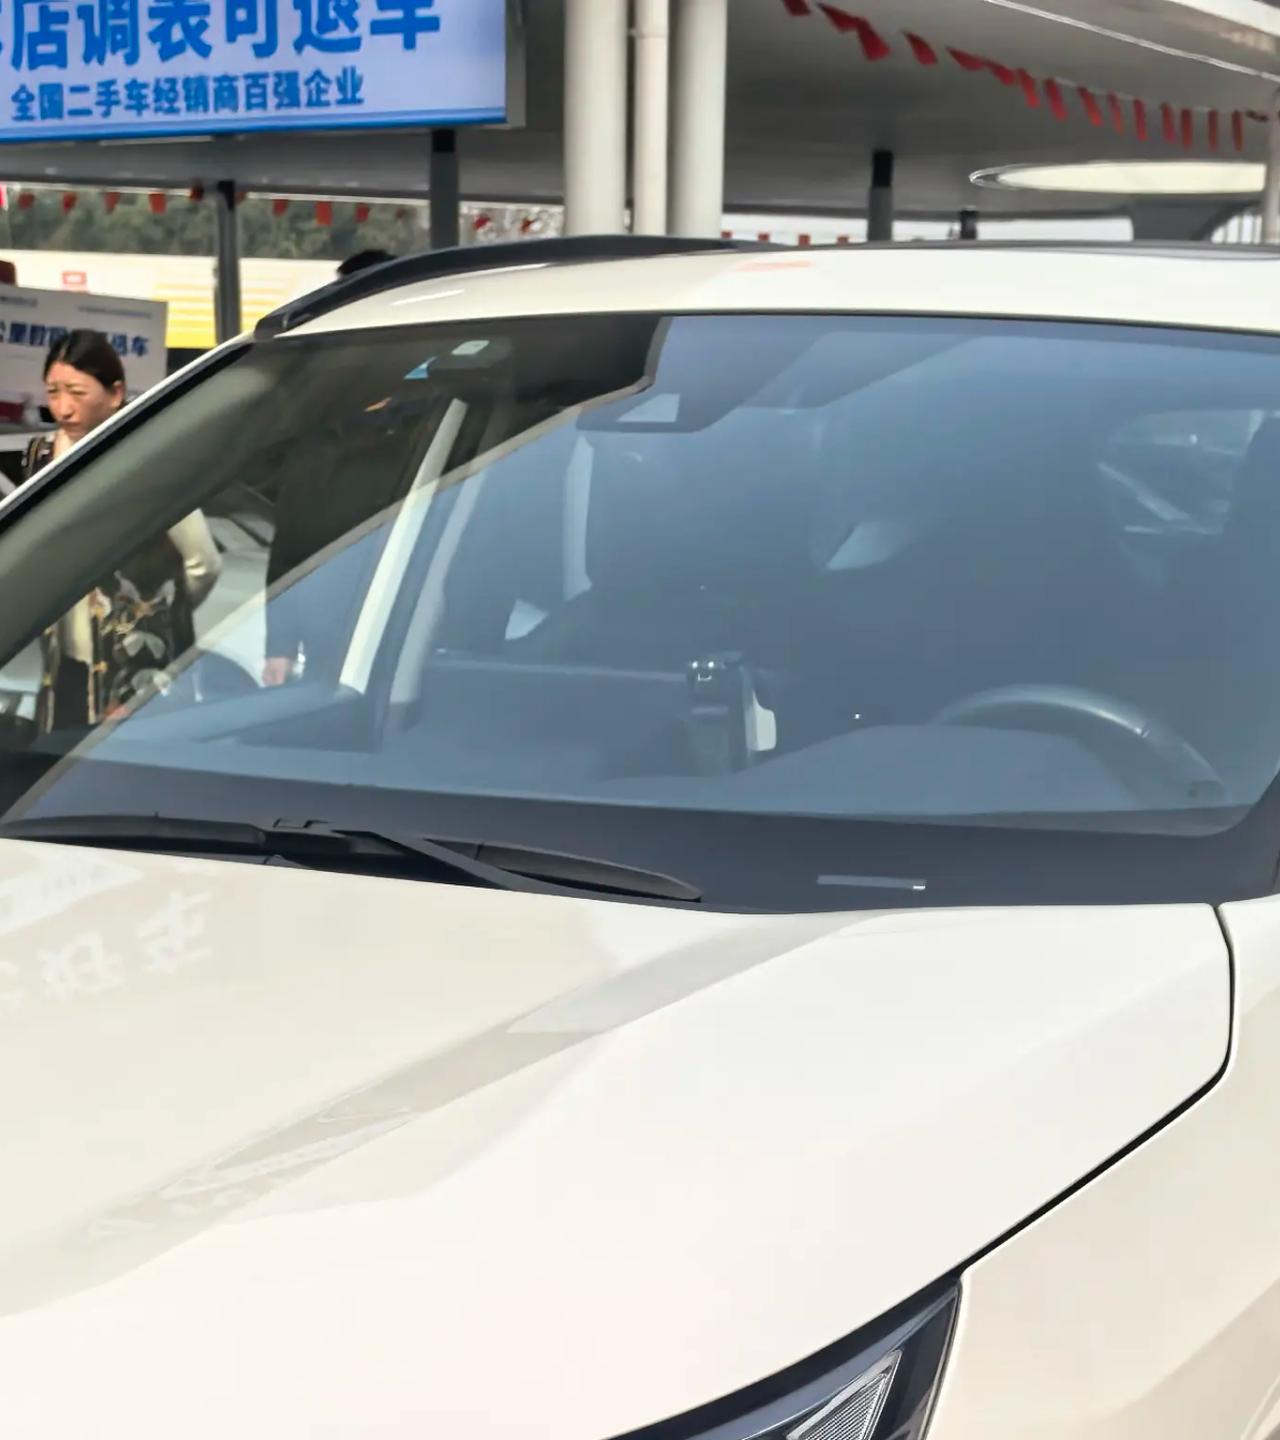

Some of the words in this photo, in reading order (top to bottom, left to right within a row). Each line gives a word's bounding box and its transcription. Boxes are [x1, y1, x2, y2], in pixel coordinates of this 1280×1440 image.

[11, 65, 364, 122] 全国二手车经销商百强企业
